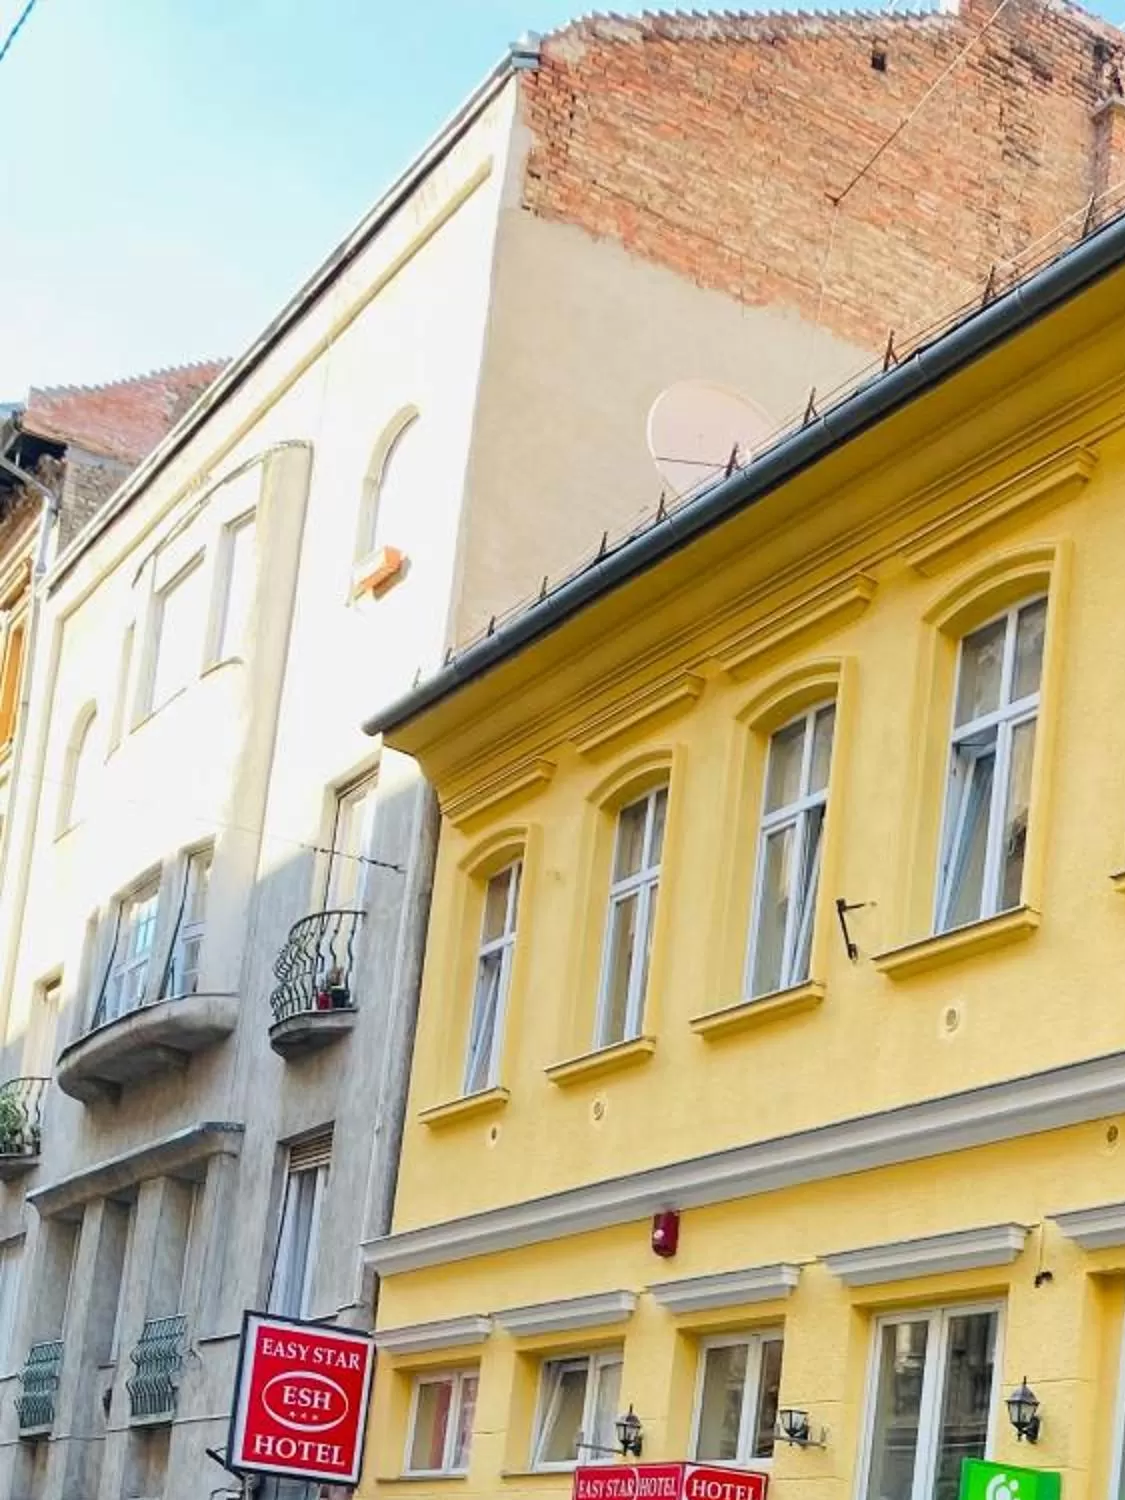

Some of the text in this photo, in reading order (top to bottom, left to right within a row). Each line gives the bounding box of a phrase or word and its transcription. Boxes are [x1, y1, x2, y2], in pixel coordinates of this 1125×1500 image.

[262, 1338, 361, 1370] EASY STAR
[283, 1385, 332, 1410] ESH
[254, 1434, 345, 1466] HOTEL
[577, 1476, 677, 1499] EASY STAR HOTEL
